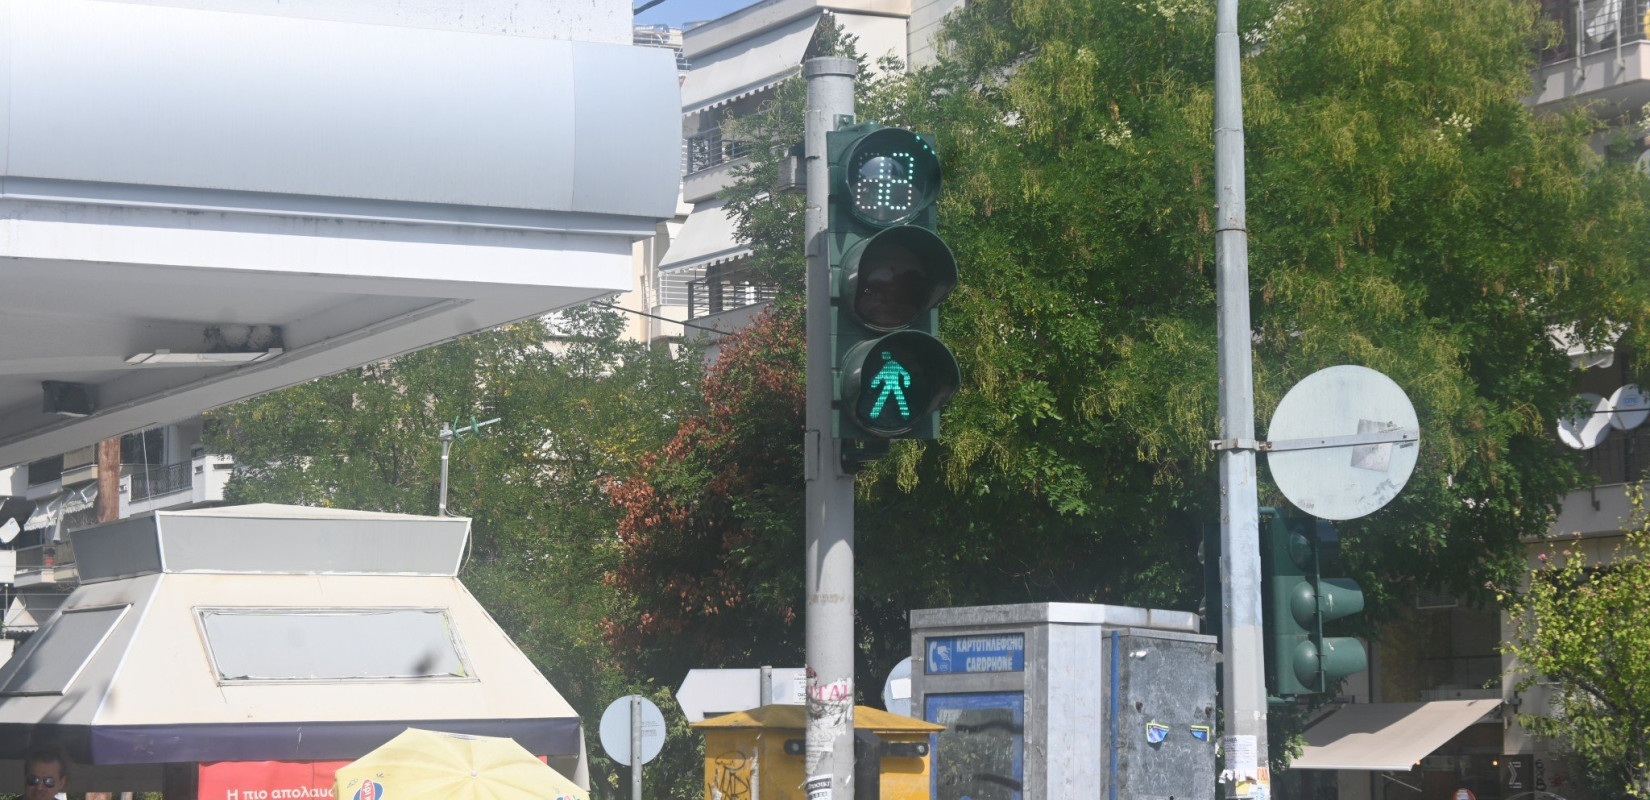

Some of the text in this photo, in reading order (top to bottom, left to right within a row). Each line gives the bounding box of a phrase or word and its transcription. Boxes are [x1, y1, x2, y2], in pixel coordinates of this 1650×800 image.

[955, 635, 1023, 653] ΚΑΡΤΟΤΗΛΕΦΩΝΟ
[966, 656, 1014, 672] CARDPHONE
[242, 791, 268, 800] πιο
